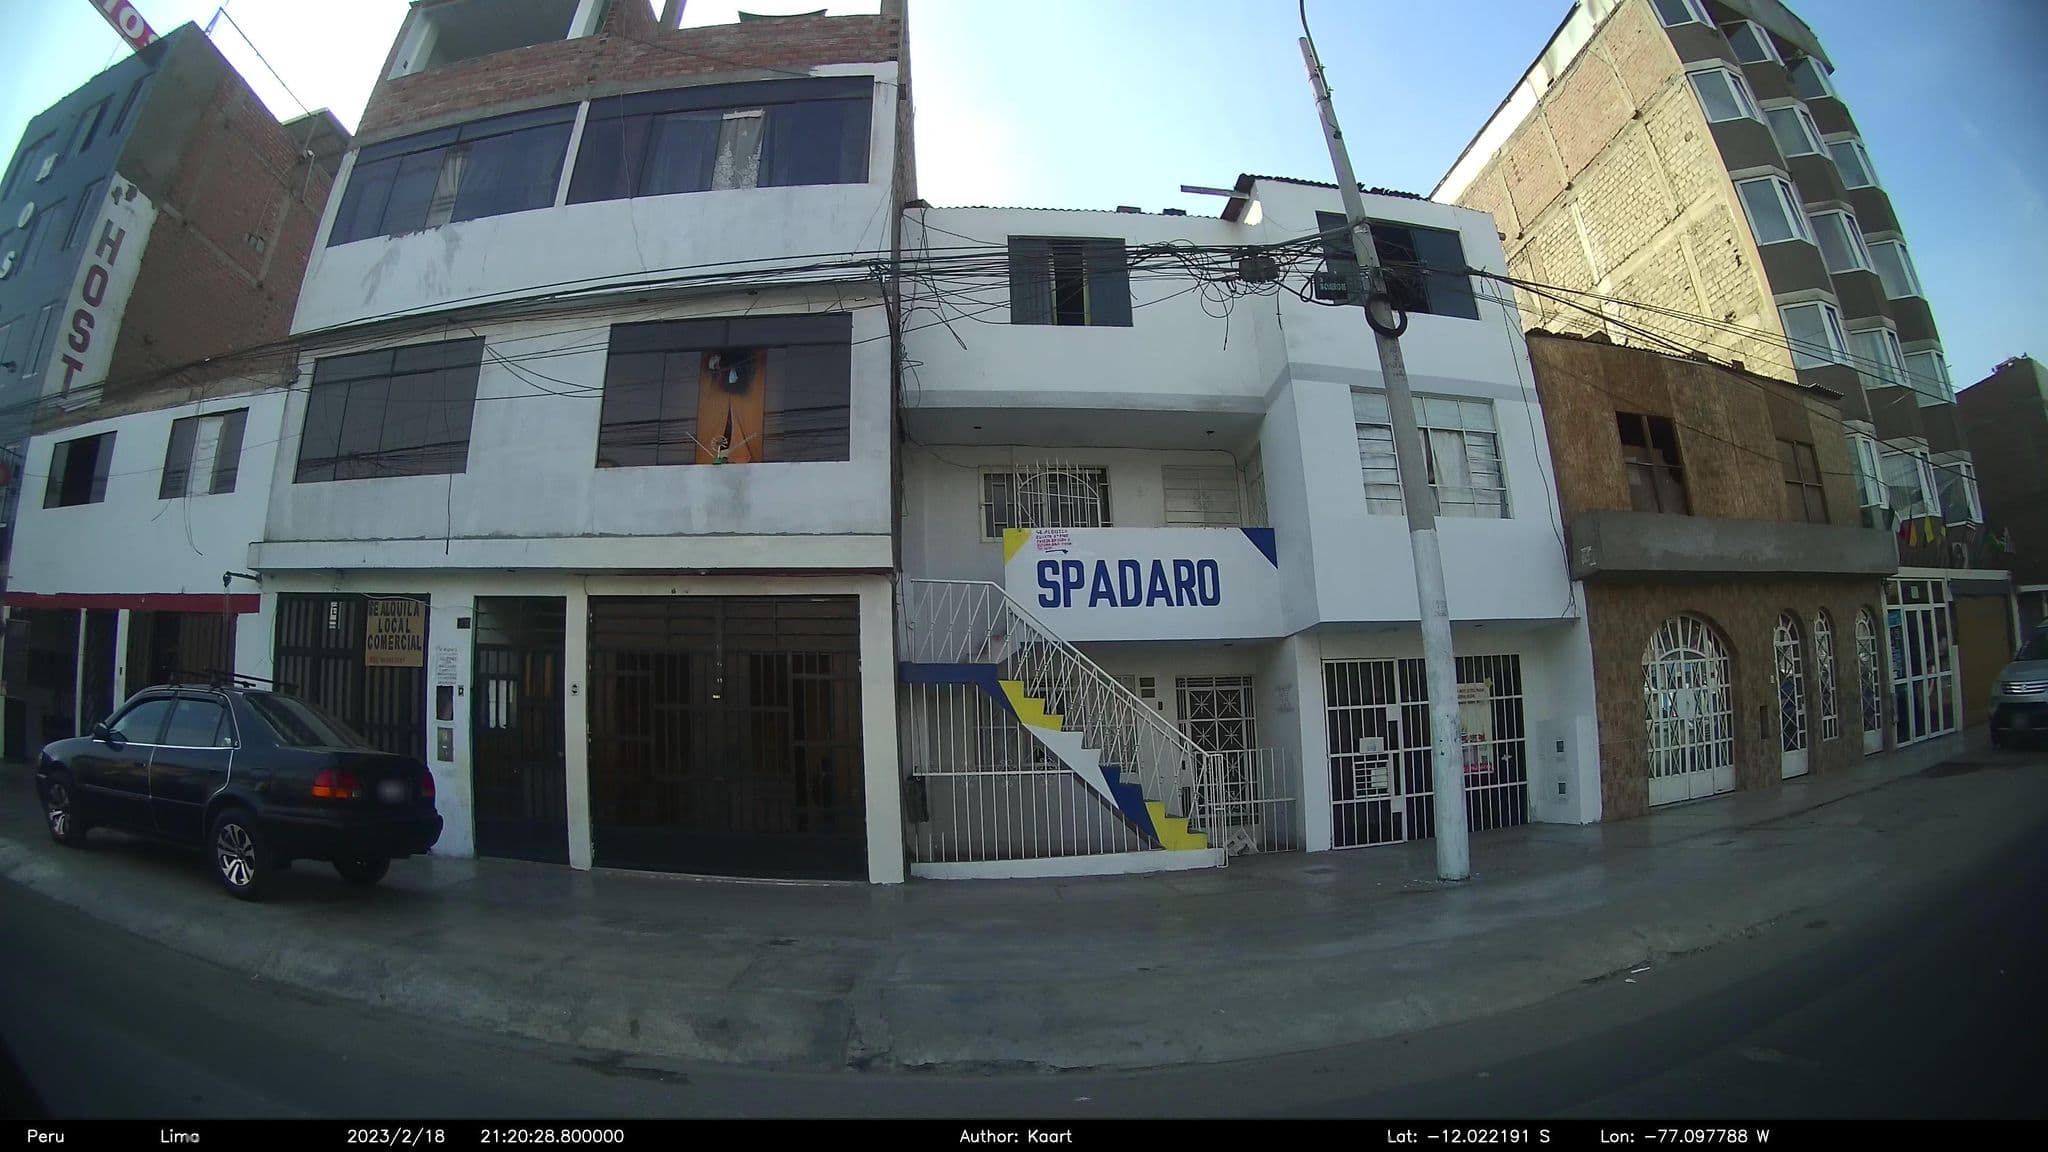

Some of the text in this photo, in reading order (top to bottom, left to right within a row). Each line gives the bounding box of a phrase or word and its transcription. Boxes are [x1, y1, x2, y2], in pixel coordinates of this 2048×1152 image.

[1037, 559, 1221, 608] SPADARO
[368, 600, 420, 617] SE ALQUILA
[378, 617, 411, 634] LOCAL
[367, 634, 422, 651] COMERCIAL
